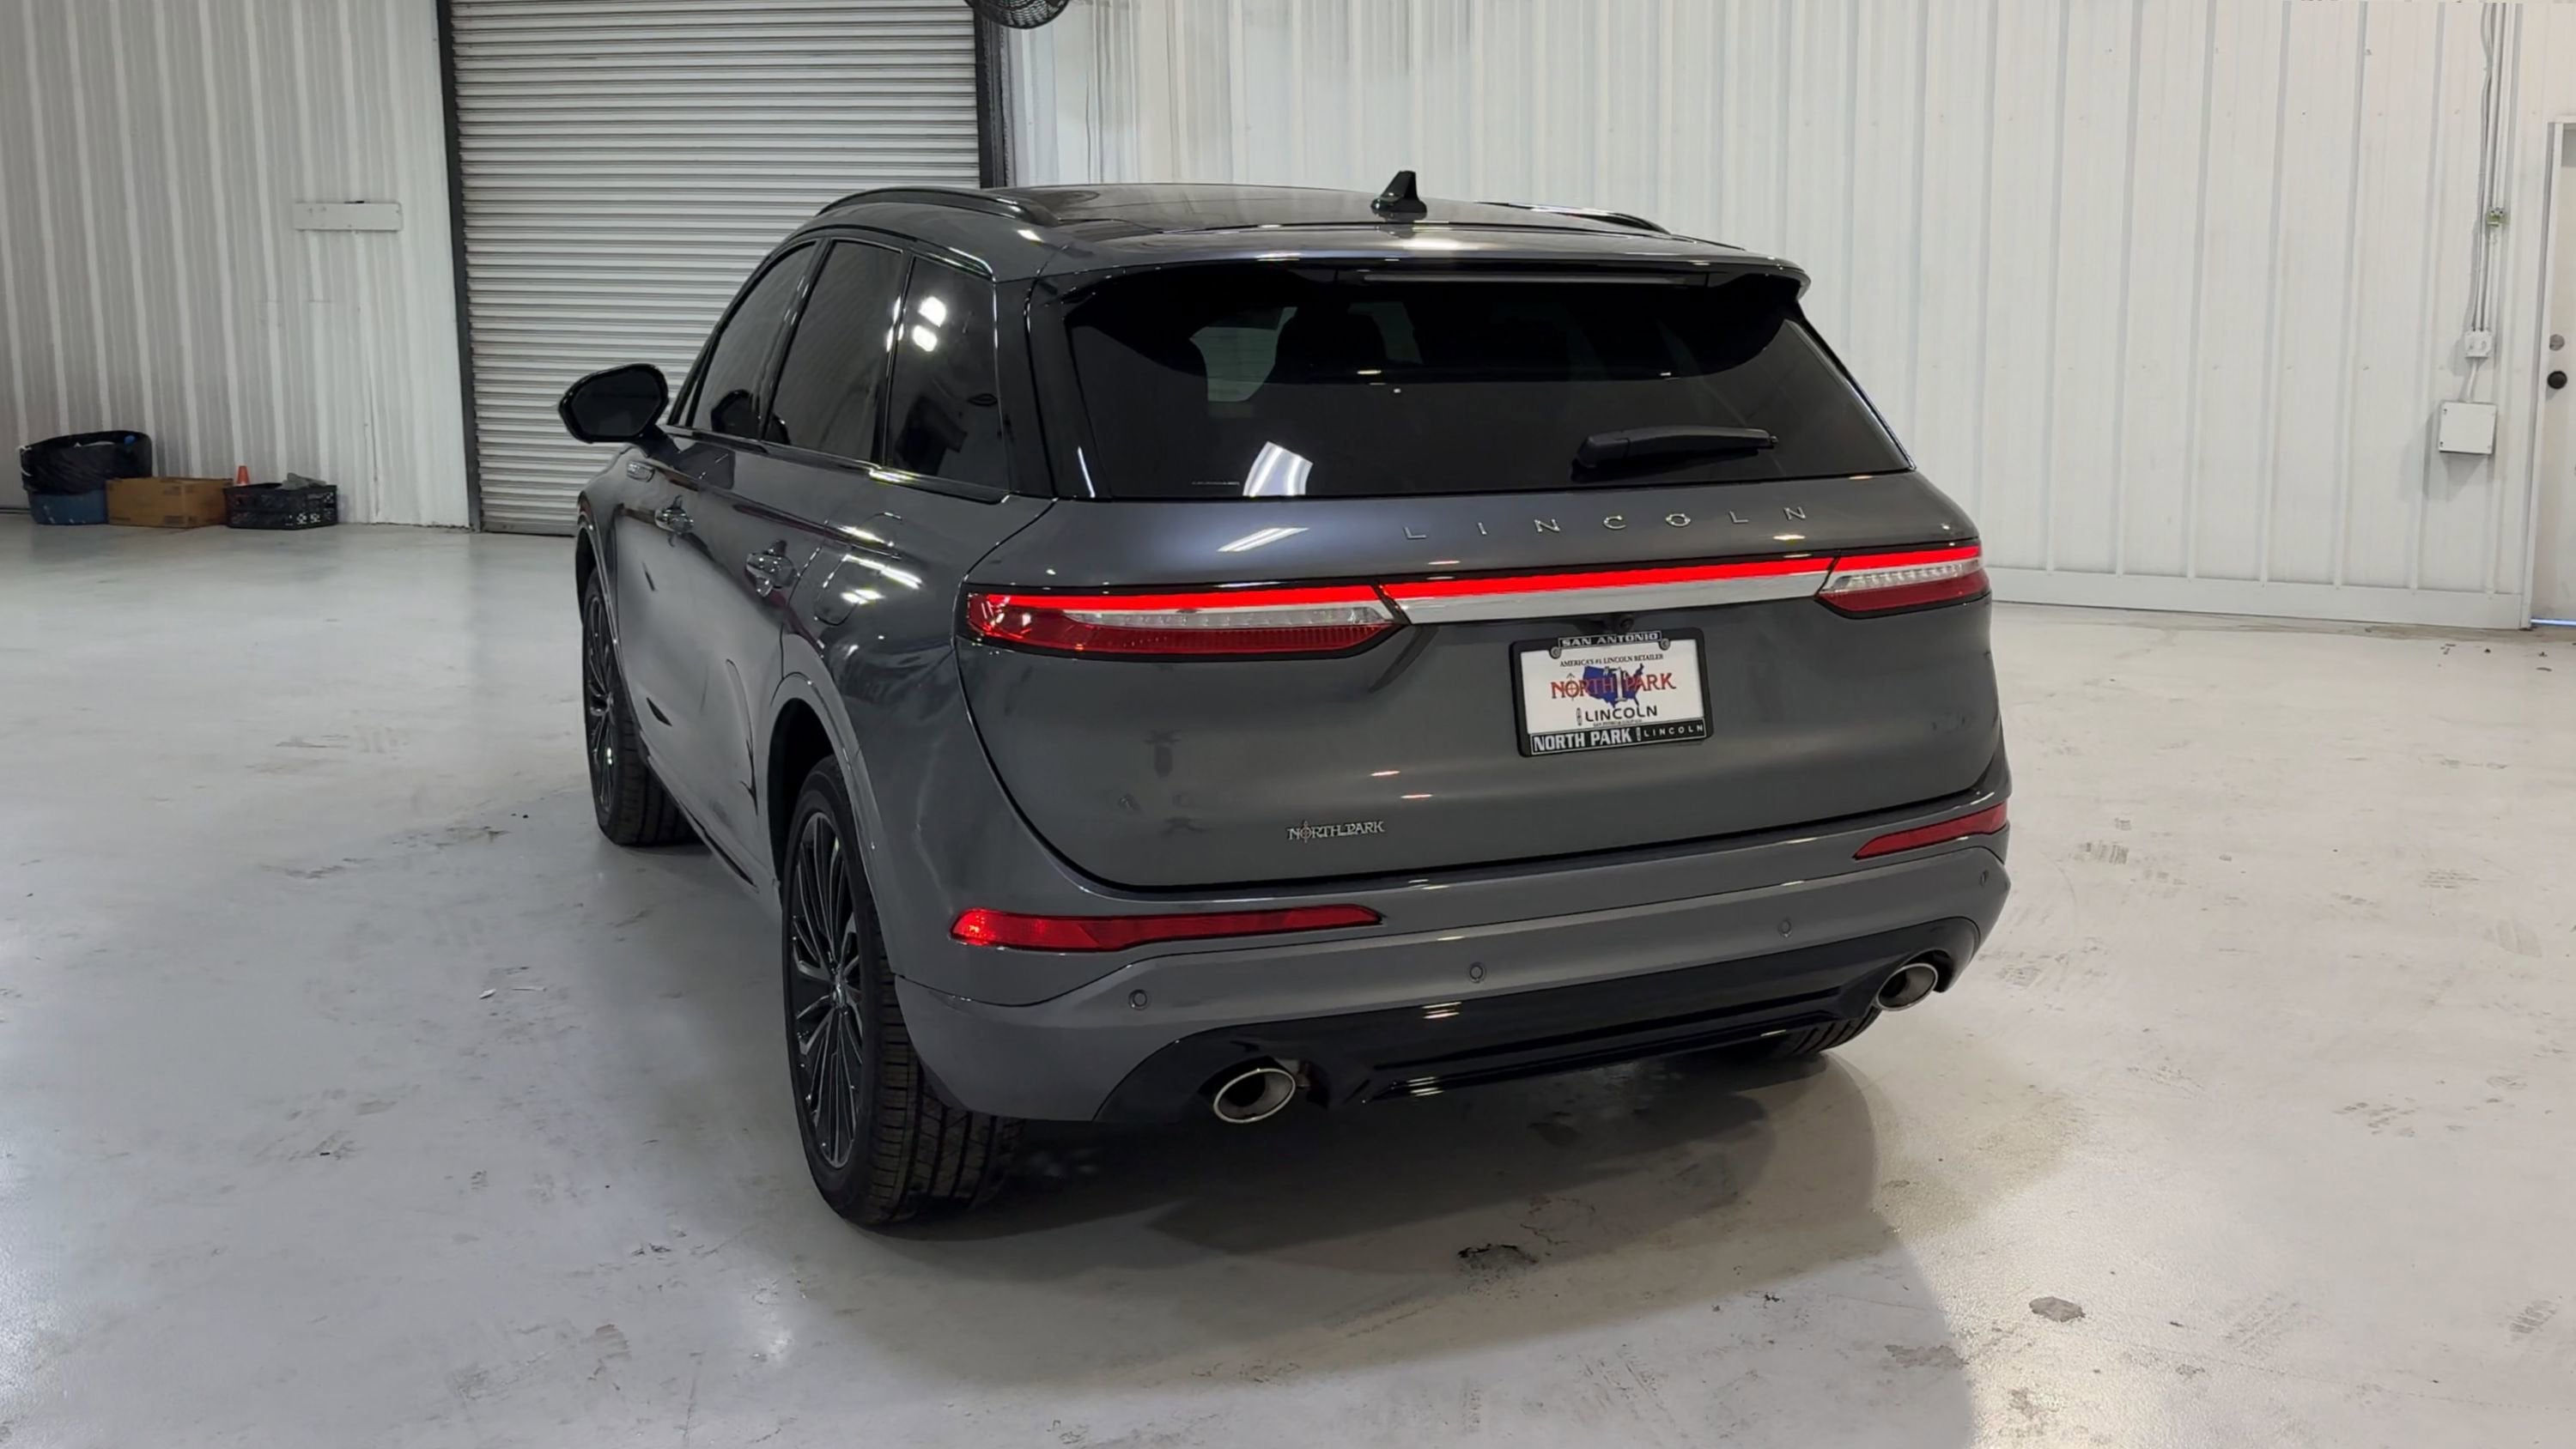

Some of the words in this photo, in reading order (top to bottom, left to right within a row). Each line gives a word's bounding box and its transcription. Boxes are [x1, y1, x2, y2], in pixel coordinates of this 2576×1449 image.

[1403, 506, 1807, 539] LINCOLN
[1562, 637, 1592, 647] SAN
[1597, 632, 1658, 645] ANTONIO
[1559, 658, 1594, 668] AMERICA'S
[1603, 654, 1633, 664] LINCOLN
[1634, 652, 1664, 663] RETAILER
[1551, 676, 1614, 700] NORTH
[1625, 673, 1676, 692] PARK
[1585, 705, 1657, 722] LINCOLN
[1534, 732, 1585, 752] NORTH
[1590, 727, 1632, 747] PARK
[1643, 724, 1704, 737] LINCOLN
